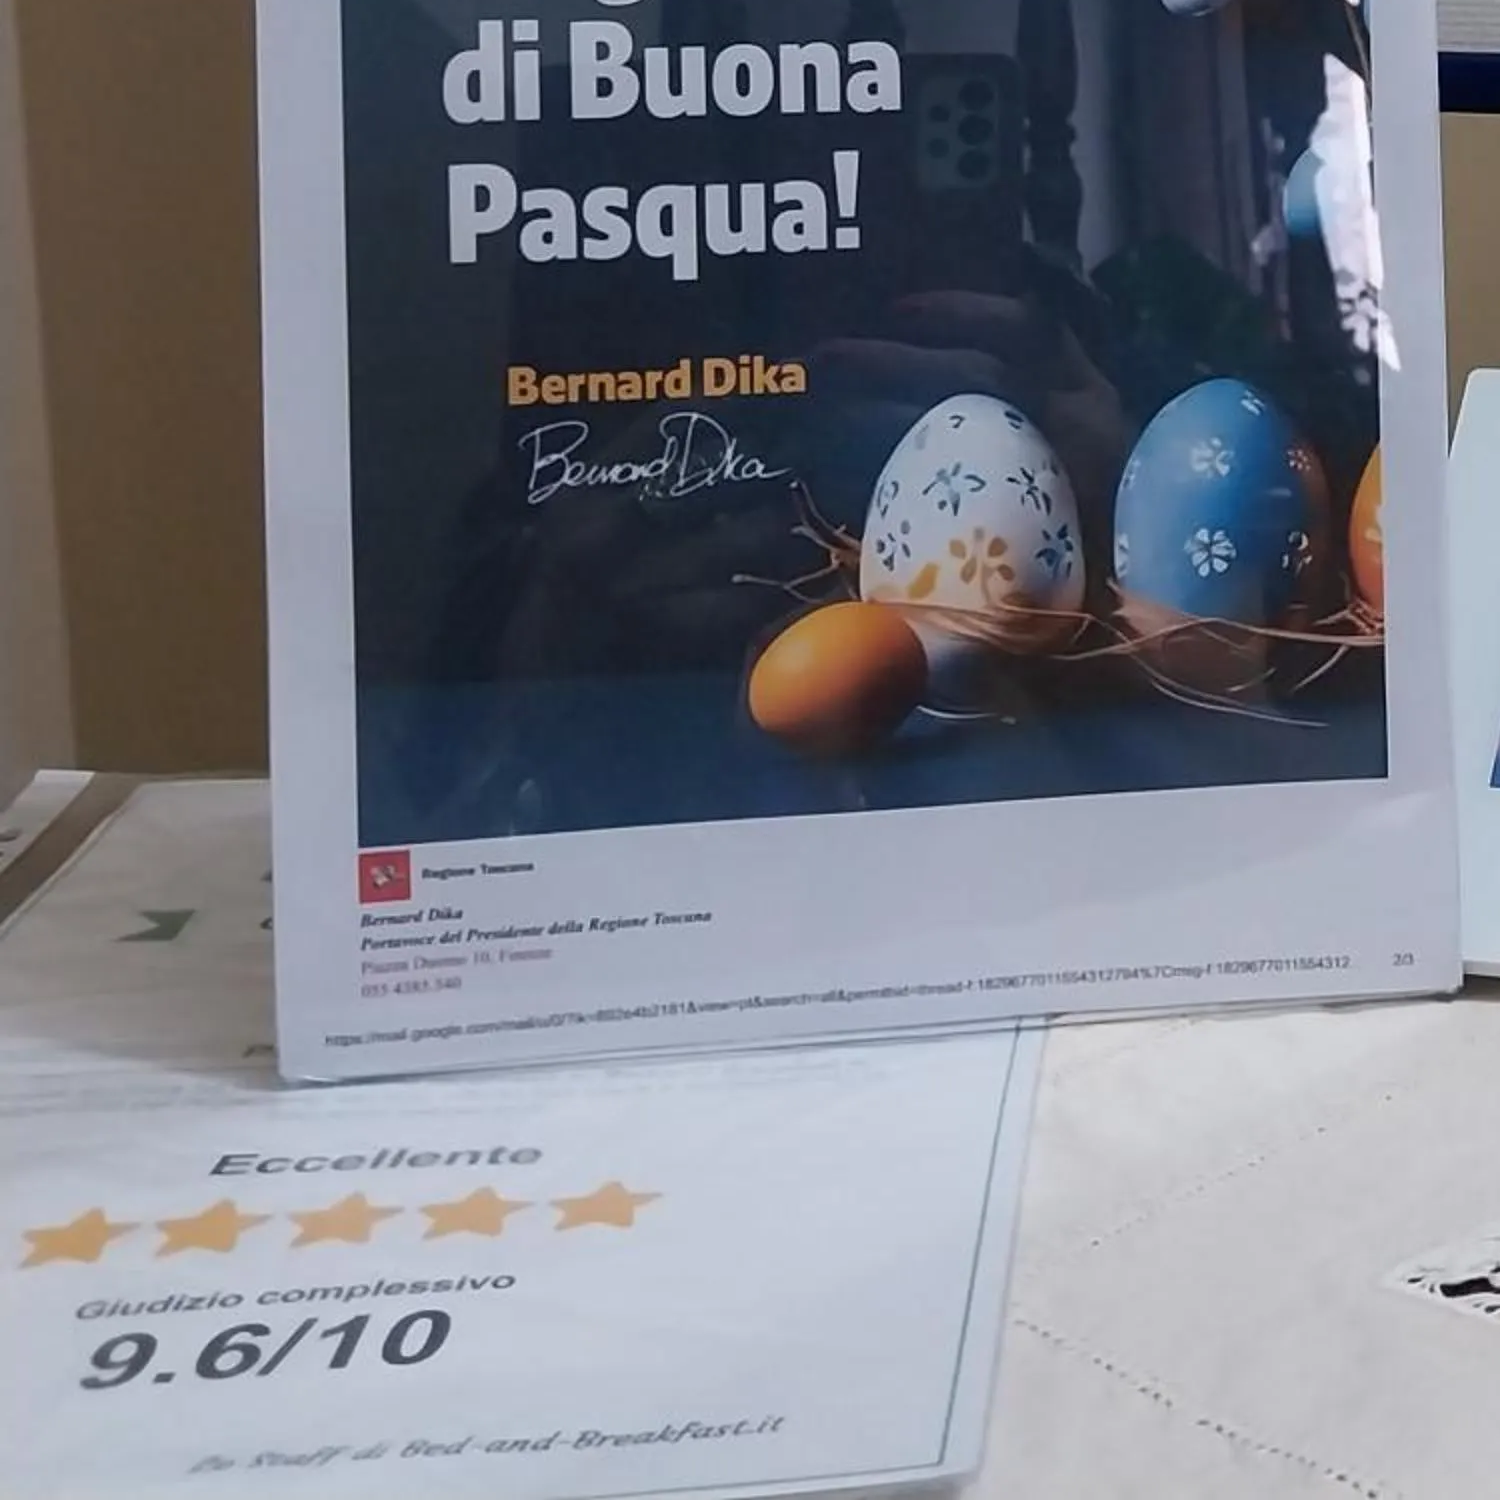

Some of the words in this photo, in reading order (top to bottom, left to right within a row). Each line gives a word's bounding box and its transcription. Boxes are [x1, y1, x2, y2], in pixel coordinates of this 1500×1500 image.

[443, 19, 542, 124] di
[570, 19, 903, 120] Buona
[447, 150, 861, 281] Pasqua!
[507, 357, 692, 406] Bernard
[703, 354, 807, 398] Dika
[360, 908, 424, 928] Bernard
[428, 907, 463, 921] Dika
[439, 930, 462, 945] del
[466, 924, 544, 944] Presidente
[547, 921, 583, 937] della
[588, 914, 649, 934] Regione
[654, 911, 712, 926] Toscana
[210, 1142, 545, 1177] Eccellente
[75, 1285, 248, 1320] Giudizio
[254, 1272, 518, 1308] complessivo
[79, 1308, 453, 1392] 9.6/10
